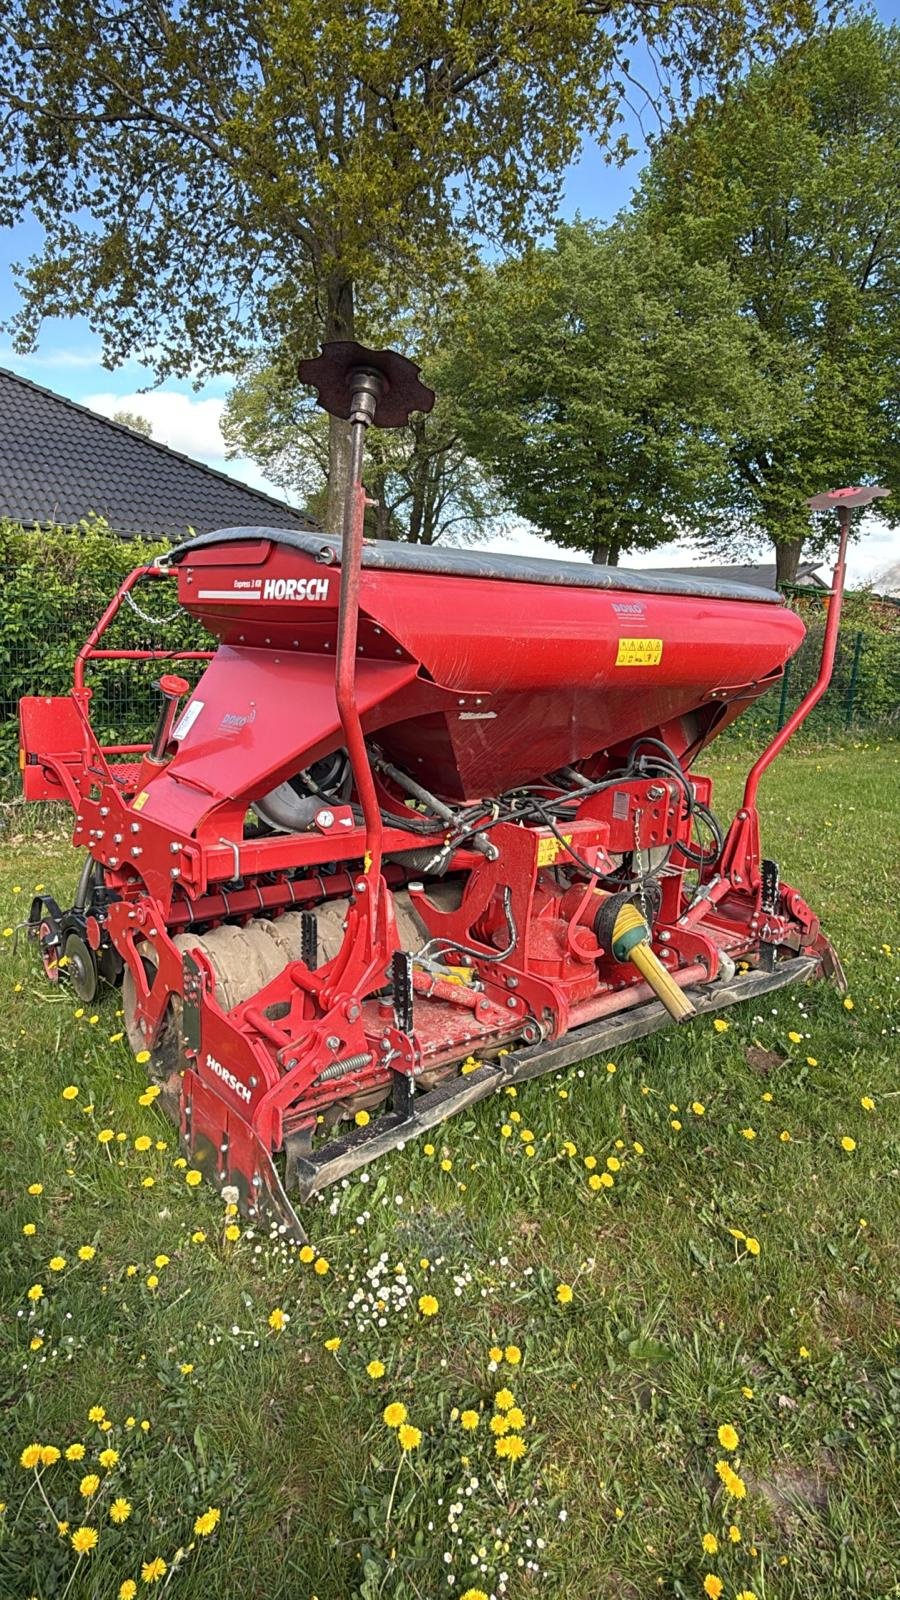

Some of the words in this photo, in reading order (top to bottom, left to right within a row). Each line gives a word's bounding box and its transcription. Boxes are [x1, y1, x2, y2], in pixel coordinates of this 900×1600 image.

[233, 579, 251, 588] Express
[263, 578, 329, 600] HORSCH
[206, 1054, 252, 1105] HORSCH
